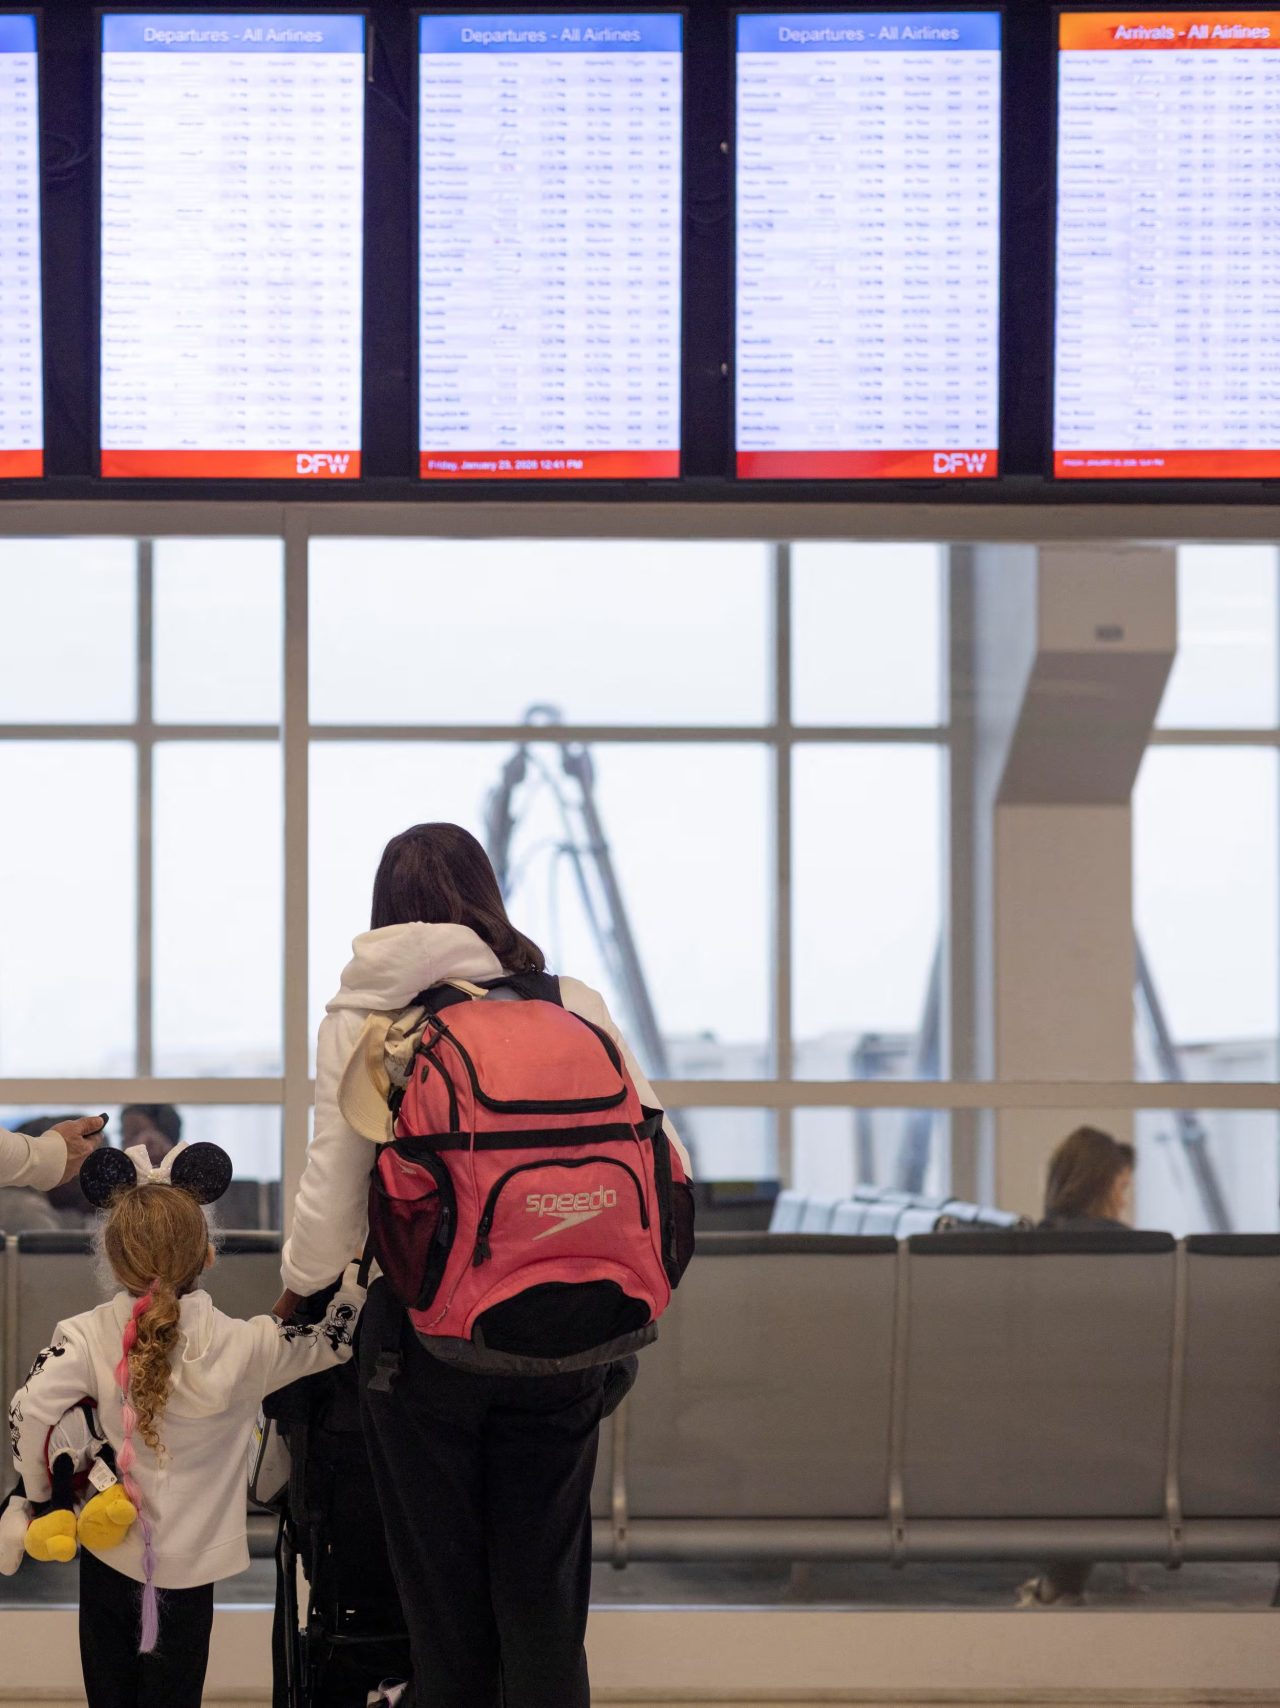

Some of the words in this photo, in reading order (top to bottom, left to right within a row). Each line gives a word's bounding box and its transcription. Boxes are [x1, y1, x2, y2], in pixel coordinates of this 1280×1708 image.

[143, 27, 230, 44] Departures
[242, 27, 262, 42] All
[266, 27, 324, 43] Airlines
[460, 28, 547, 45] Departures
[560, 28, 580, 42] All
[583, 27, 641, 43] Airlines
[778, 26, 865, 44] Departures
[878, 26, 899, 40] All
[901, 25, 960, 41] Airlines
[1114, 24, 1175, 40] Arrivals
[1187, 24, 1208, 39] All
[1211, 24, 1271, 40] Airlines
[296, 453, 350, 474] DFW
[461, 460, 497, 472] January
[566, 459, 583, 469] PM
[933, 452, 987, 474] DFW
[525, 1184, 617, 1217] speedo
